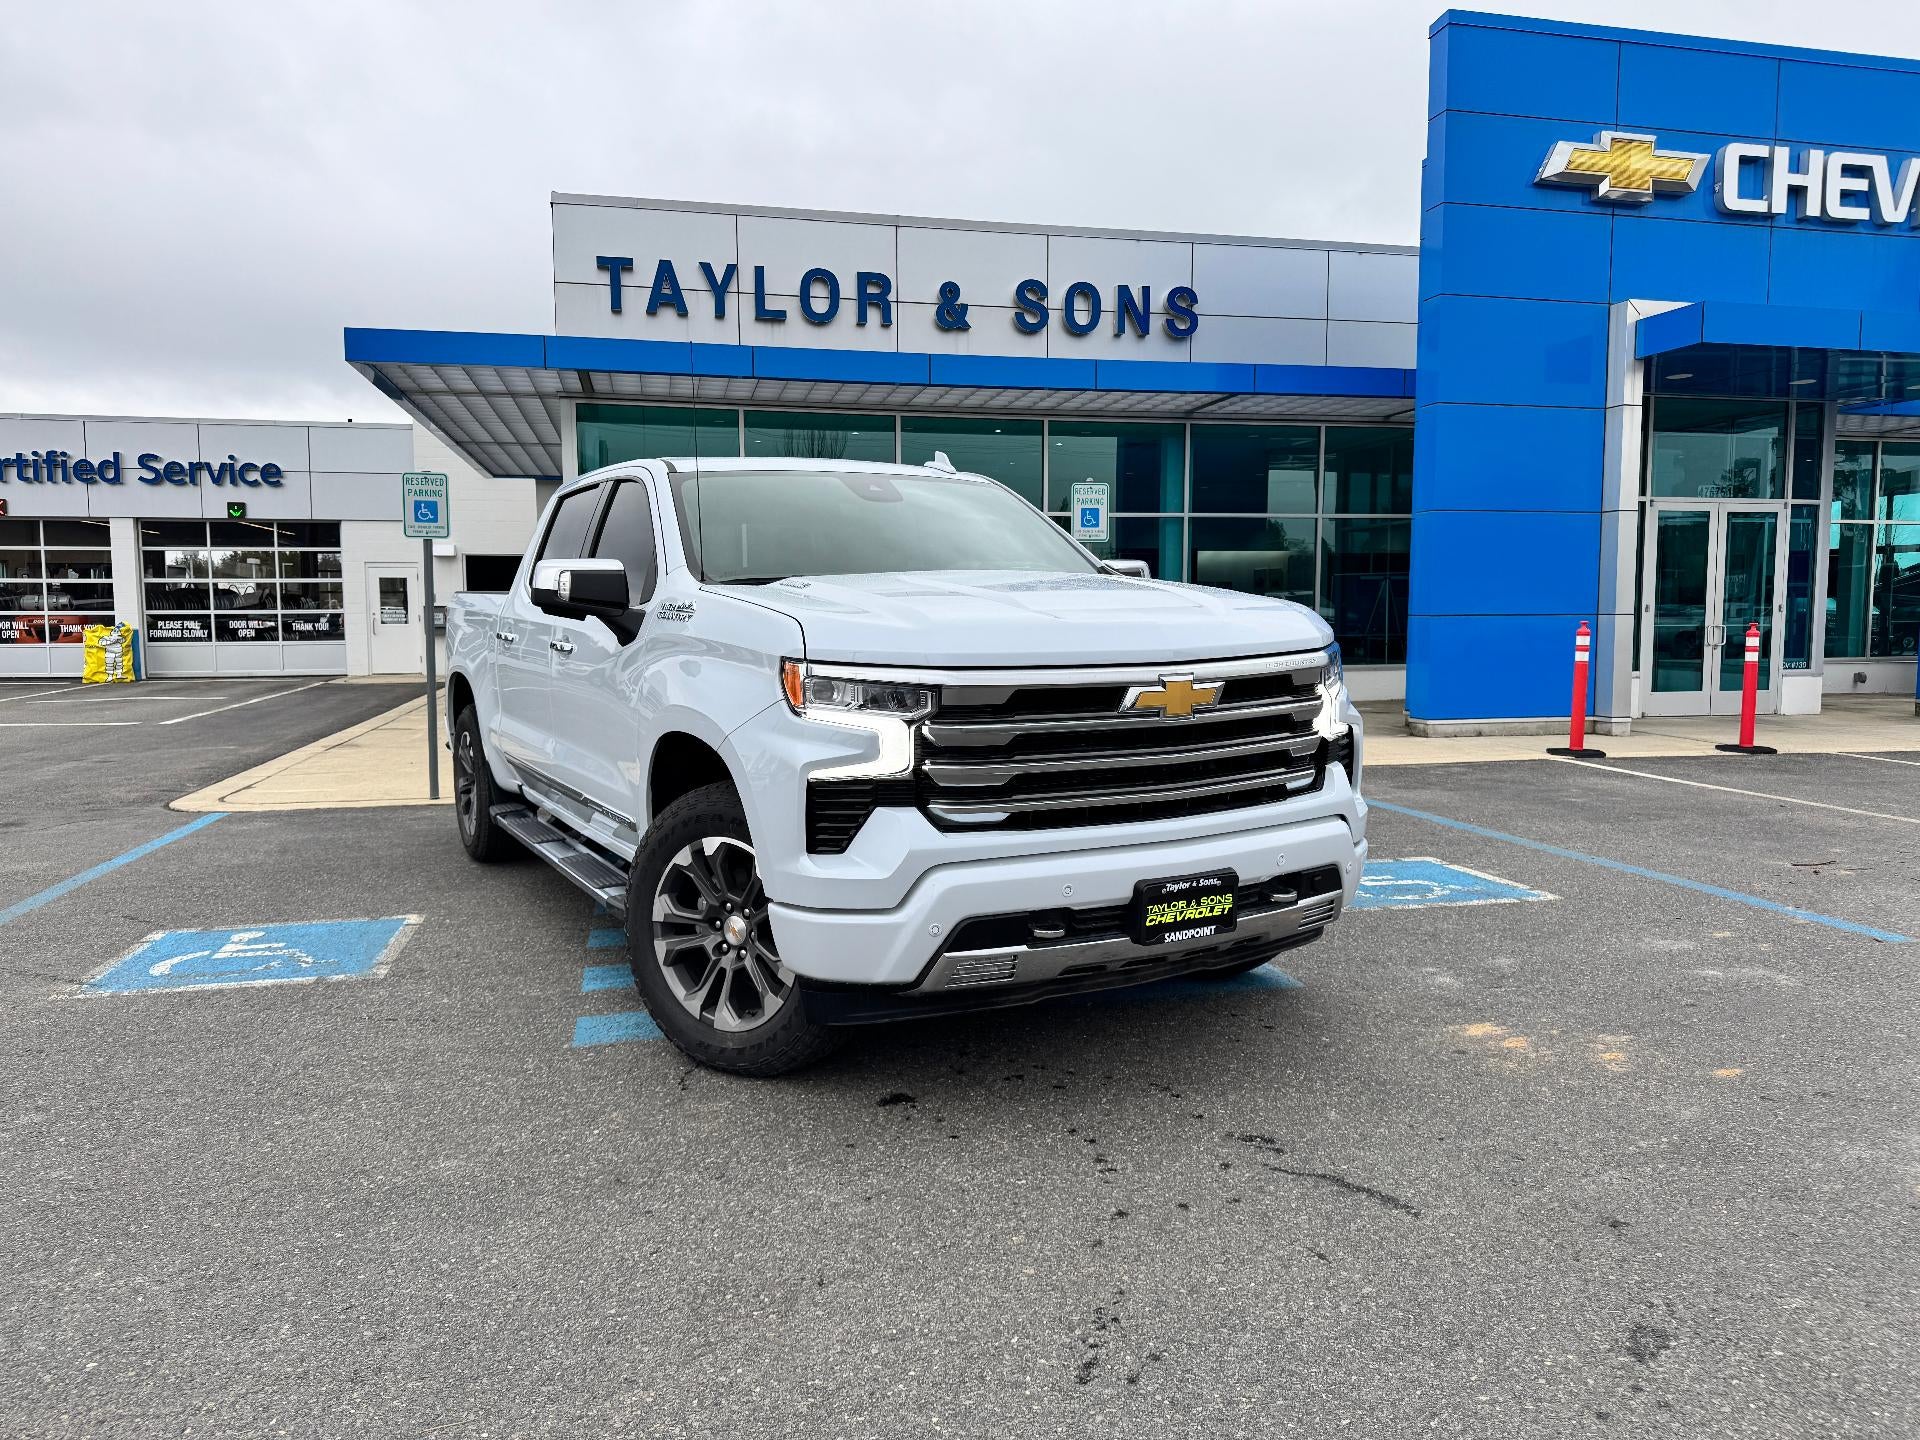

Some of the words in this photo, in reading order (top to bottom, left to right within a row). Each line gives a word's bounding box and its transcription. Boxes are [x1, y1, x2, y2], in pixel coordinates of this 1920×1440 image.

[596, 255, 893, 327] TAYLOR
[935, 281, 972, 330] &
[1014, 279, 1199, 337] SONS
[137, 453, 283, 487] Service
[405, 477, 444, 486] RESERVED
[407, 489, 443, 497] PARKING
[1075, 487, 1106, 496] RESERVED
[1076, 498, 1104, 506] PARKING
[12, 621, 29, 630] WILL
[59, 624, 82, 633] THANK
[157, 621, 183, 629] PLEASE
[184, 621, 202, 630] PULL
[229, 621, 247, 629] DOOR
[248, 621, 264, 629] WILL
[292, 623, 313, 631] THANK
[314, 623, 329, 631] YOU!
[1, 630, 20, 639] OPEN
[149, 629, 182, 638] FORWARD
[182, 629, 208, 638] SLOWLY
[237, 629, 255, 638] OPEN
[1166, 881, 1191, 892] Taylor
[1198, 878, 1218, 887] Sons
[1146, 900, 1187, 915] TAYLOR
[1190, 899, 1198, 909] &
[1200, 894, 1233, 906] SONS
[1145, 904, 1233, 926] CHEVROLET
[1164, 925, 1216, 943] SANDPOINT
